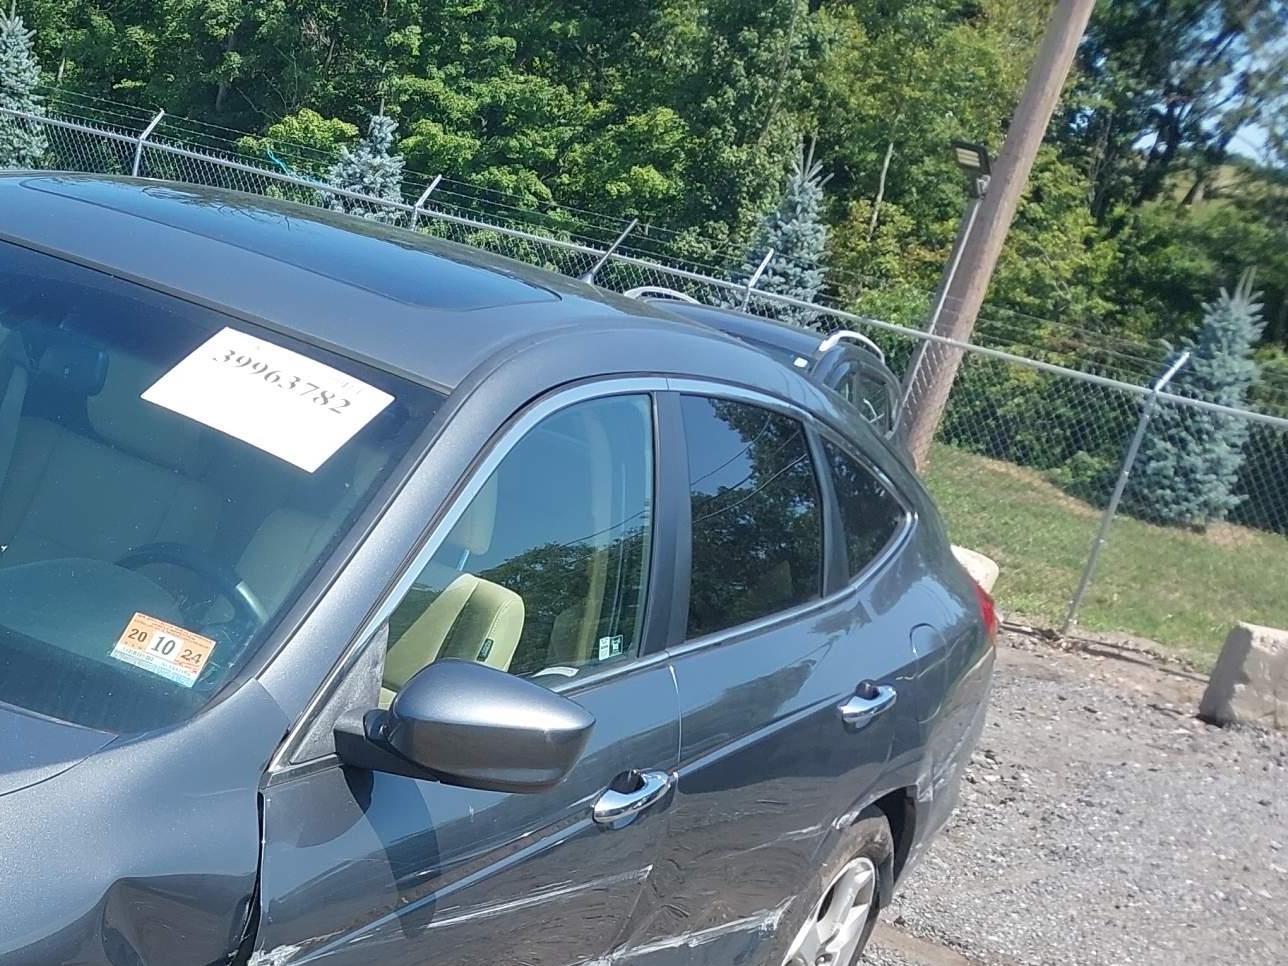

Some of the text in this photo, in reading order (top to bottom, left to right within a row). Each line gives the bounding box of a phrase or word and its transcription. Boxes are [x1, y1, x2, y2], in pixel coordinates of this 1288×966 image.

[212, 349, 352, 415] 39963782
[127, 628, 148, 643] 20
[151, 636, 176, 656] 10
[180, 648, 203, 664] 24
